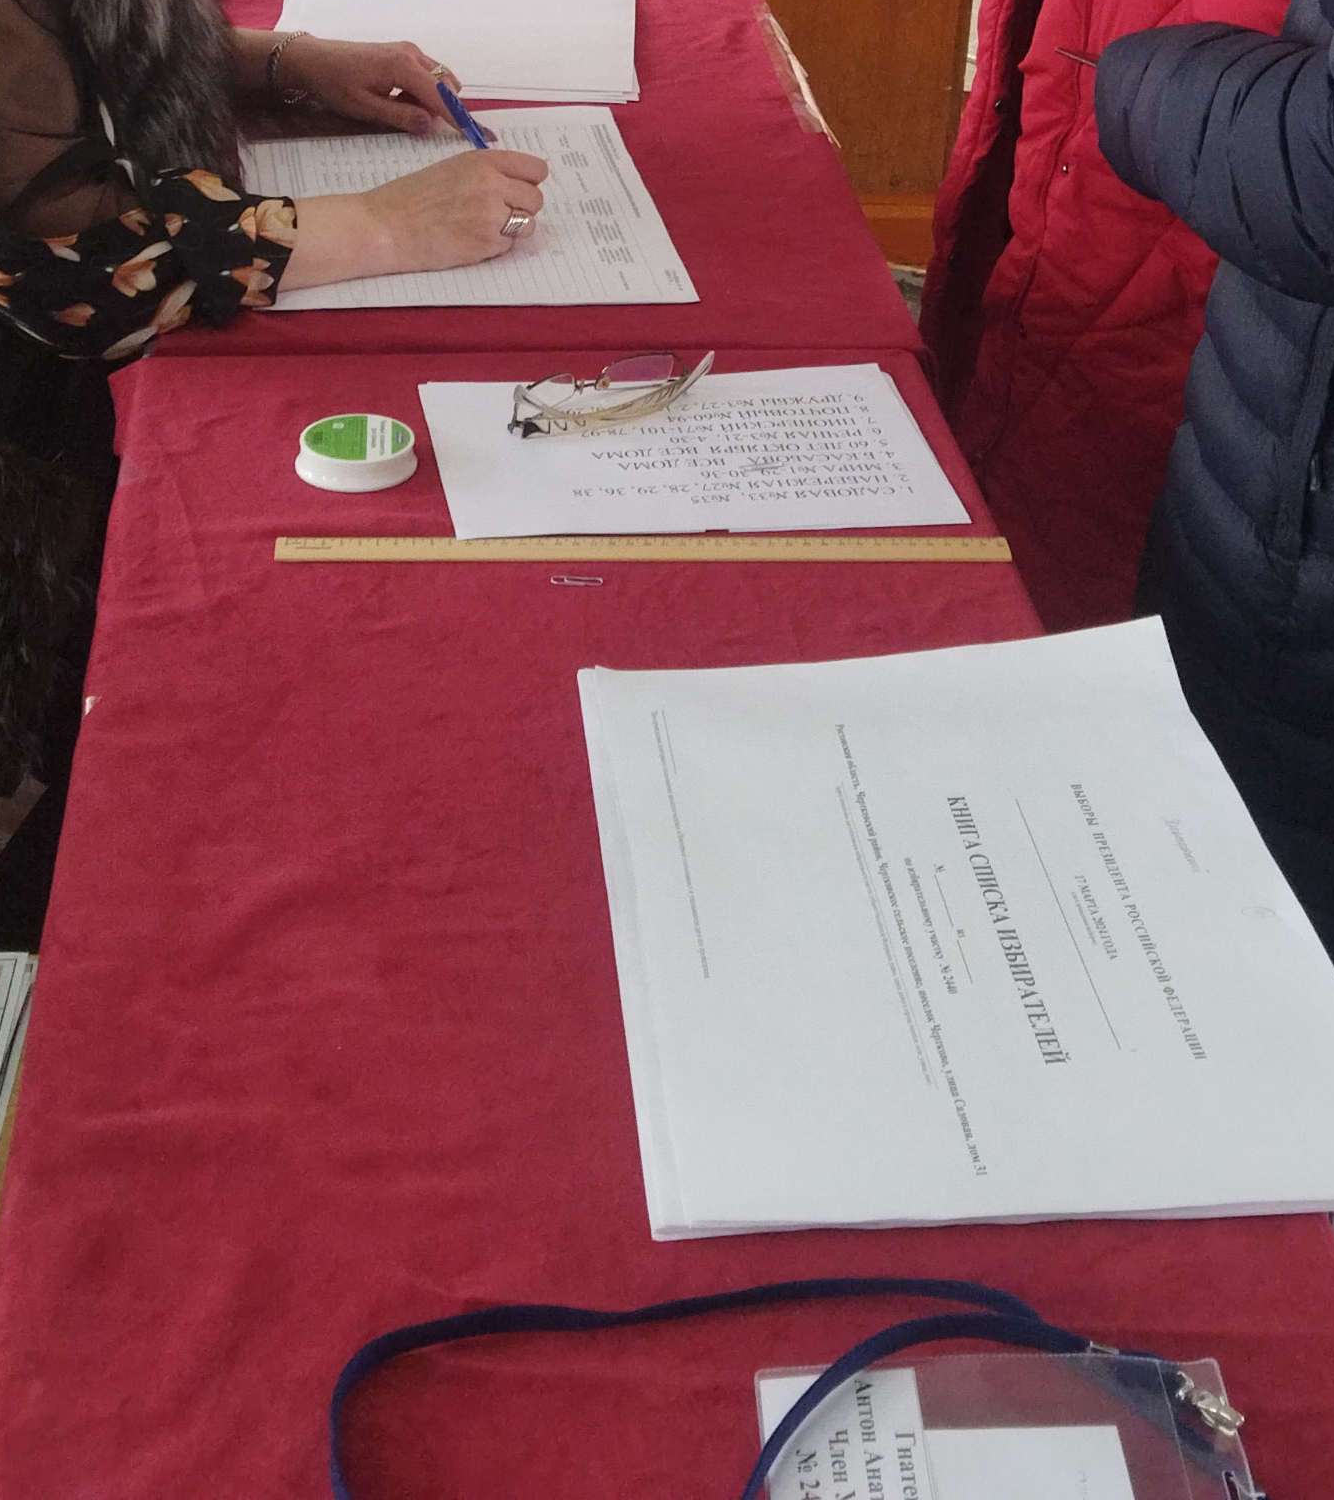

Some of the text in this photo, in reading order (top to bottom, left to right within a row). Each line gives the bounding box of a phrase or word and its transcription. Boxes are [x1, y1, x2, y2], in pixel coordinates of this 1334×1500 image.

[761, 393, 842, 406] ДРУЖБЫ
[738, 406, 849, 419] ПОЧТОВЫЙ
[720, 417, 856, 433] ПИОНЕРСКИЙ
[784, 429, 862, 439] РЕЧНАЯ
[658, 446, 698, 456] ВСЕ
[709, 443, 800, 454] ОКТЯБРЯ
[806, 442, 842, 450] ЛЕТ
[591, 447, 652, 460] ДОМА
[618, 458, 679, 471] ДОМА
[685, 457, 725, 468] ВСЕ
[823, 463, 882, 472] МИРА
[748, 474, 888, 489] НАБЕРЕЖНАЯ
[795, 486, 895, 499] САДОВАЯ
[1070, 783, 1207, 1060] ВЫБОРЫ ПРЕЗИДЕНТА РОССИЙСКОЙ ФЕДЕРАЦИИ
[1080, 884, 1099, 916] МАРТА
[1100, 935, 1118, 960] ГОДА
[946, 796, 1071, 1065] КНИГА СПИСКА ИЗБИРАТЕЛЕЙ
[853, 1379, 878, 1444] Антон
[795, 1448, 819, 1474] №
[828, 1429, 850, 1483] Член
[894, 1431, 919, 1500] Гнате
